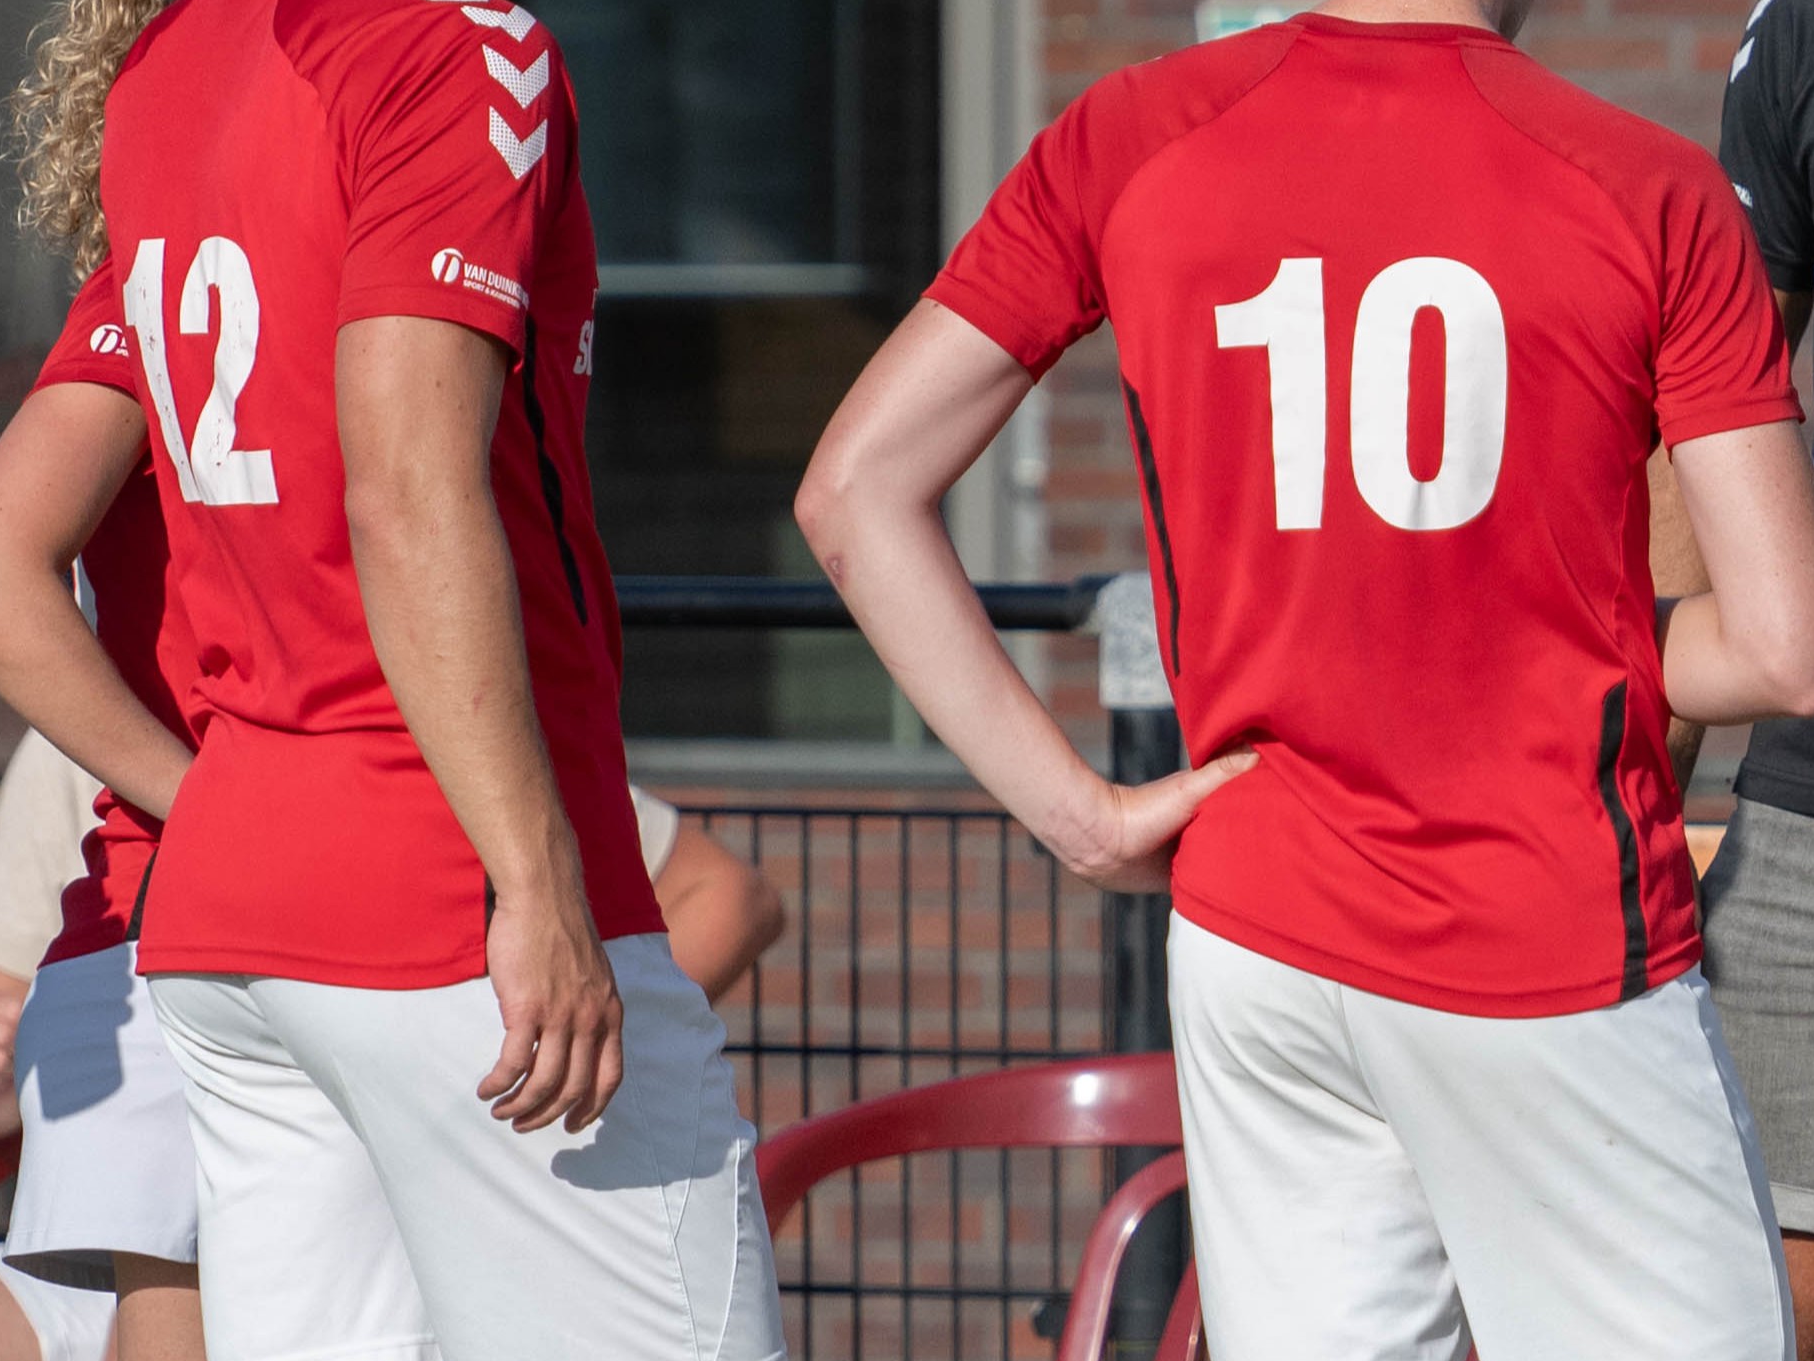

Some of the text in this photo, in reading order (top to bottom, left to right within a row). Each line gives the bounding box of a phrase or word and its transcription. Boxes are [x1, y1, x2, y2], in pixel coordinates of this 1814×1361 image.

[123, 236, 279, 507] 12
[464, 263, 487, 283] VAN
[1214, 256, 1507, 531] 10
